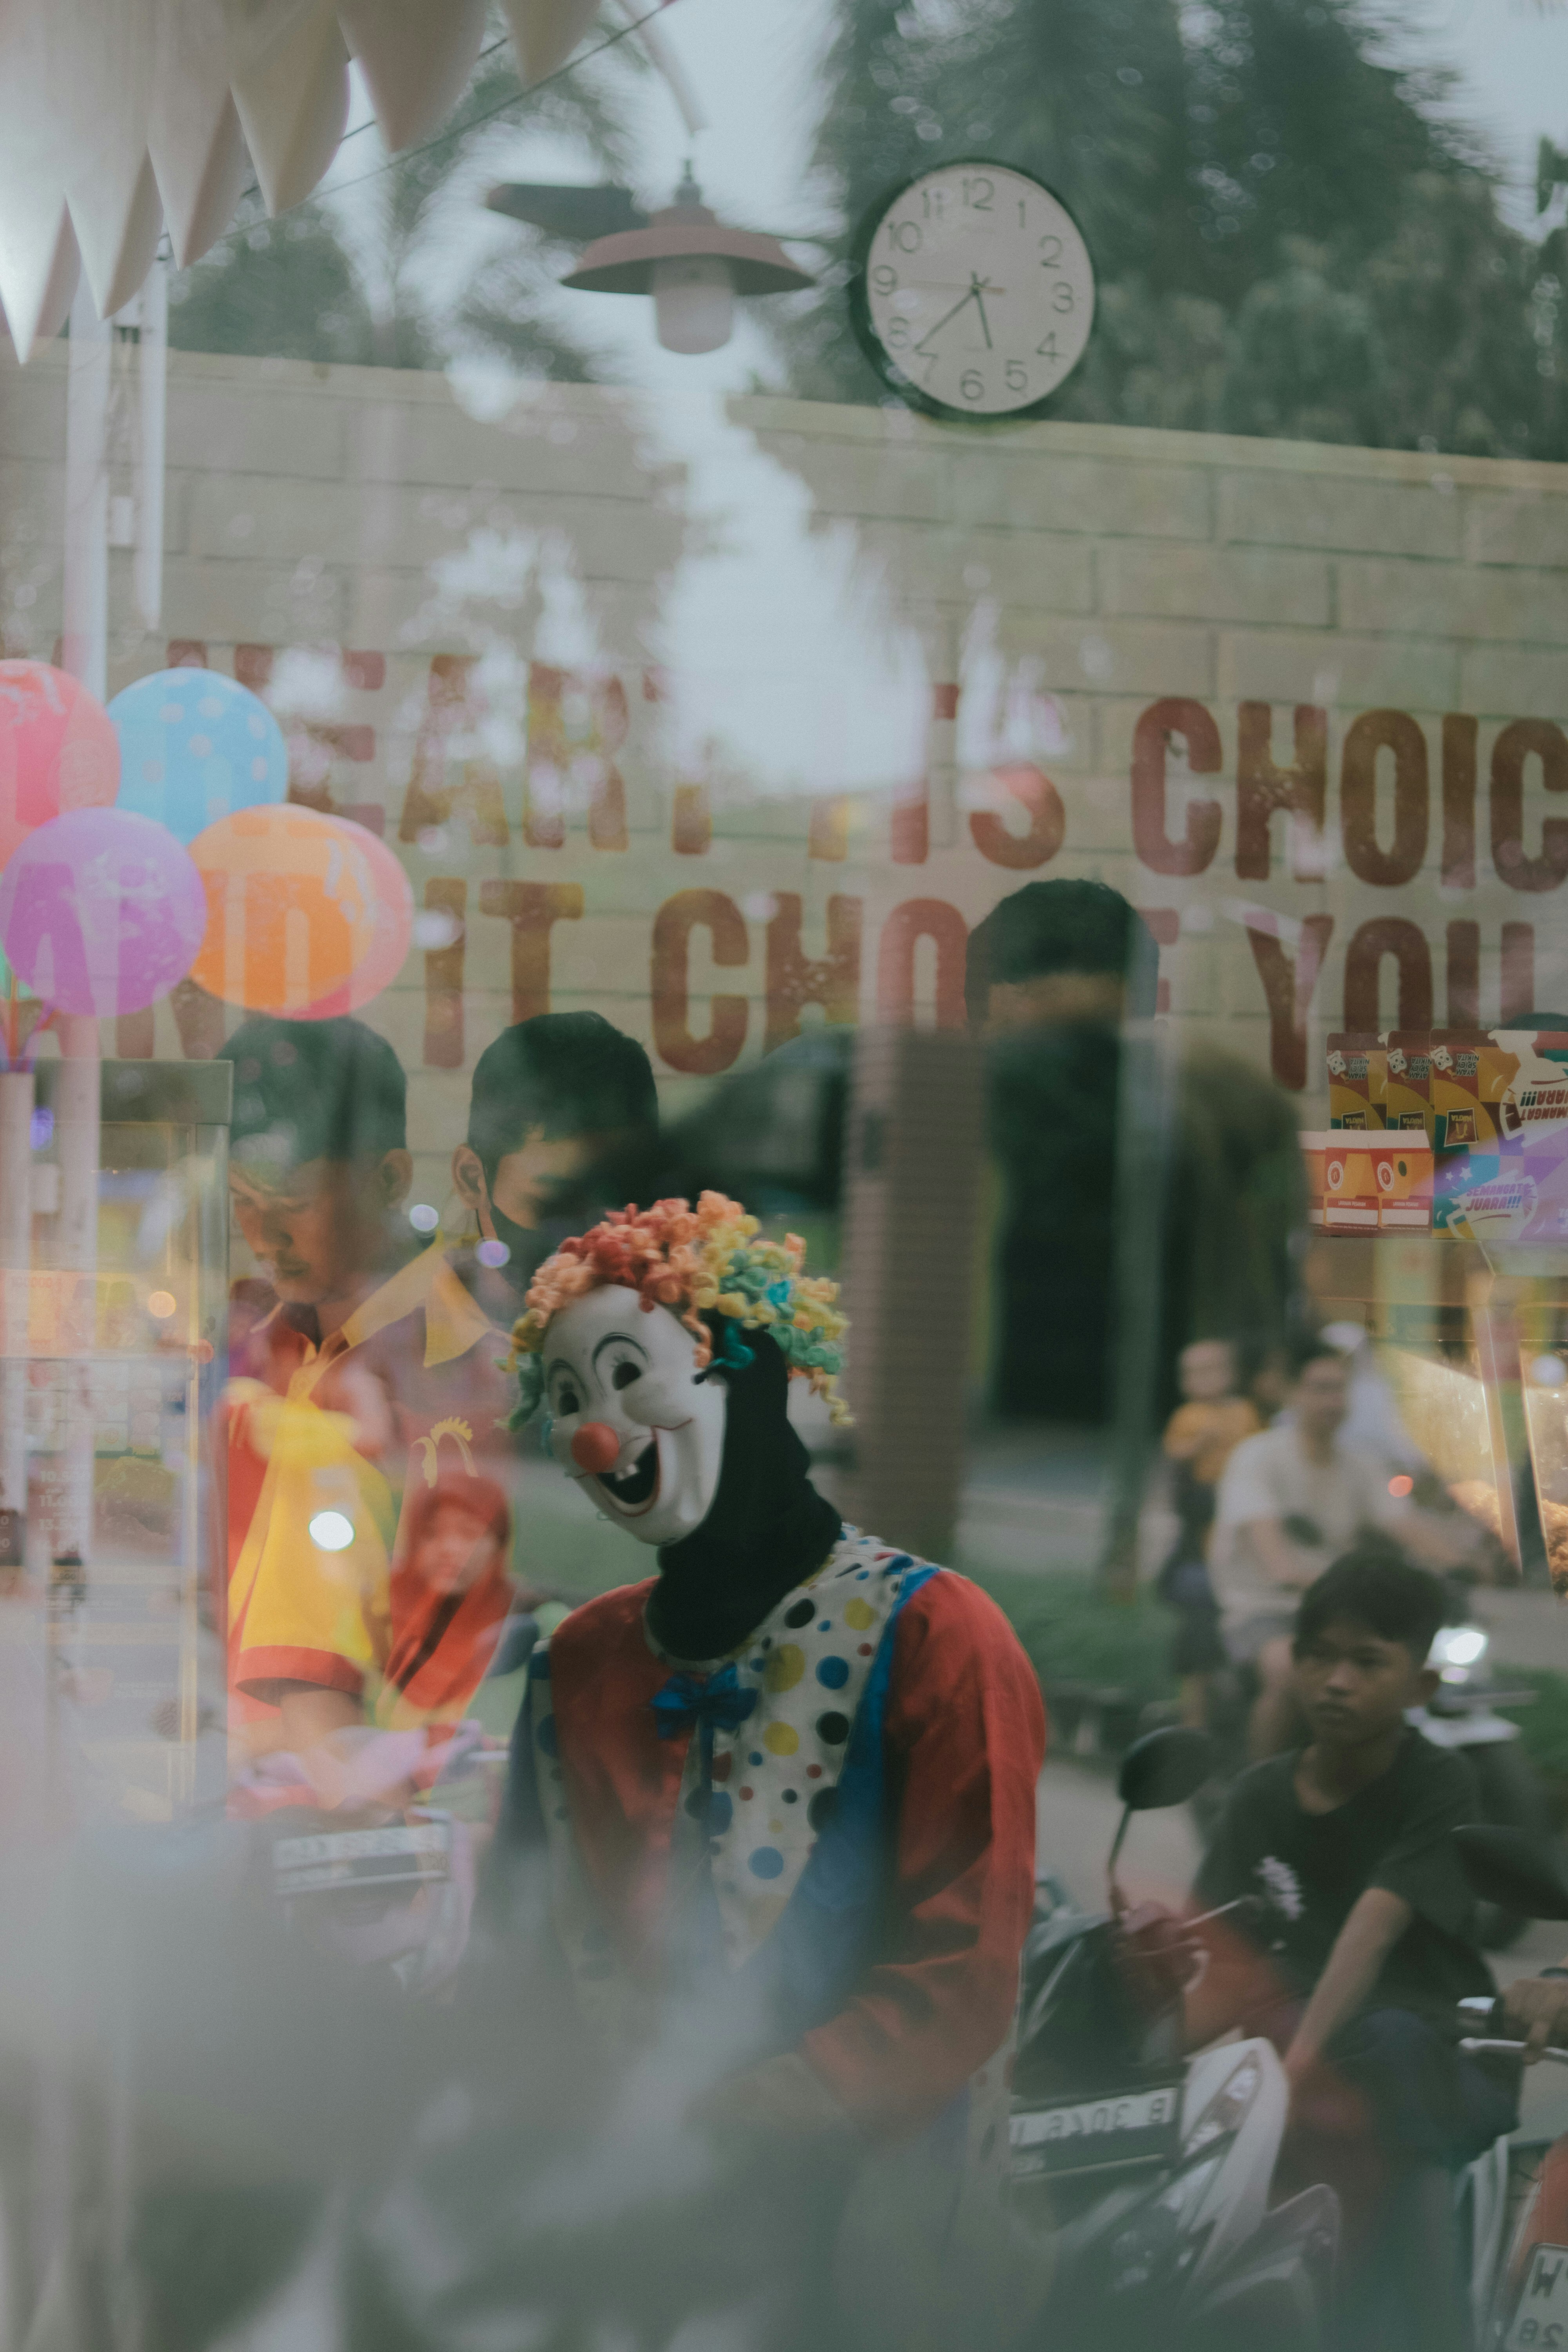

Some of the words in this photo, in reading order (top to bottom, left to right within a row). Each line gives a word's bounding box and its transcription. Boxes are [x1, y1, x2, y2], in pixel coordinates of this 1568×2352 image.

[922, 189, 942, 220] 11
[960, 177, 995, 211] 12
[1018, 200, 1026, 229] 1
[888, 221, 922, 253] 10
[1039, 235, 1063, 269] 2
[871, 265, 897, 296] 9
[1052, 281, 1074, 313] 3
[887, 316, 909, 348] 8
[1036, 331, 1058, 363] 4
[915, 351, 938, 383] 7
[1005, 359, 1027, 391] 5
[960, 369, 984, 400] 6
[1131, 696, 1568, 893] CHOIC
[423, 877, 584, 1069] IT
[653, 887, 1181, 1076] CHO
[1245, 911, 1535, 1091] YOU
[1520, 1089, 1568, 1107] ARA!!!
[1520, 1106, 1568, 1121] MANGAT
[1465, 1195, 1523, 1211] JUARA!!!
[1466, 1183, 1523, 1196] SEMANGAT
